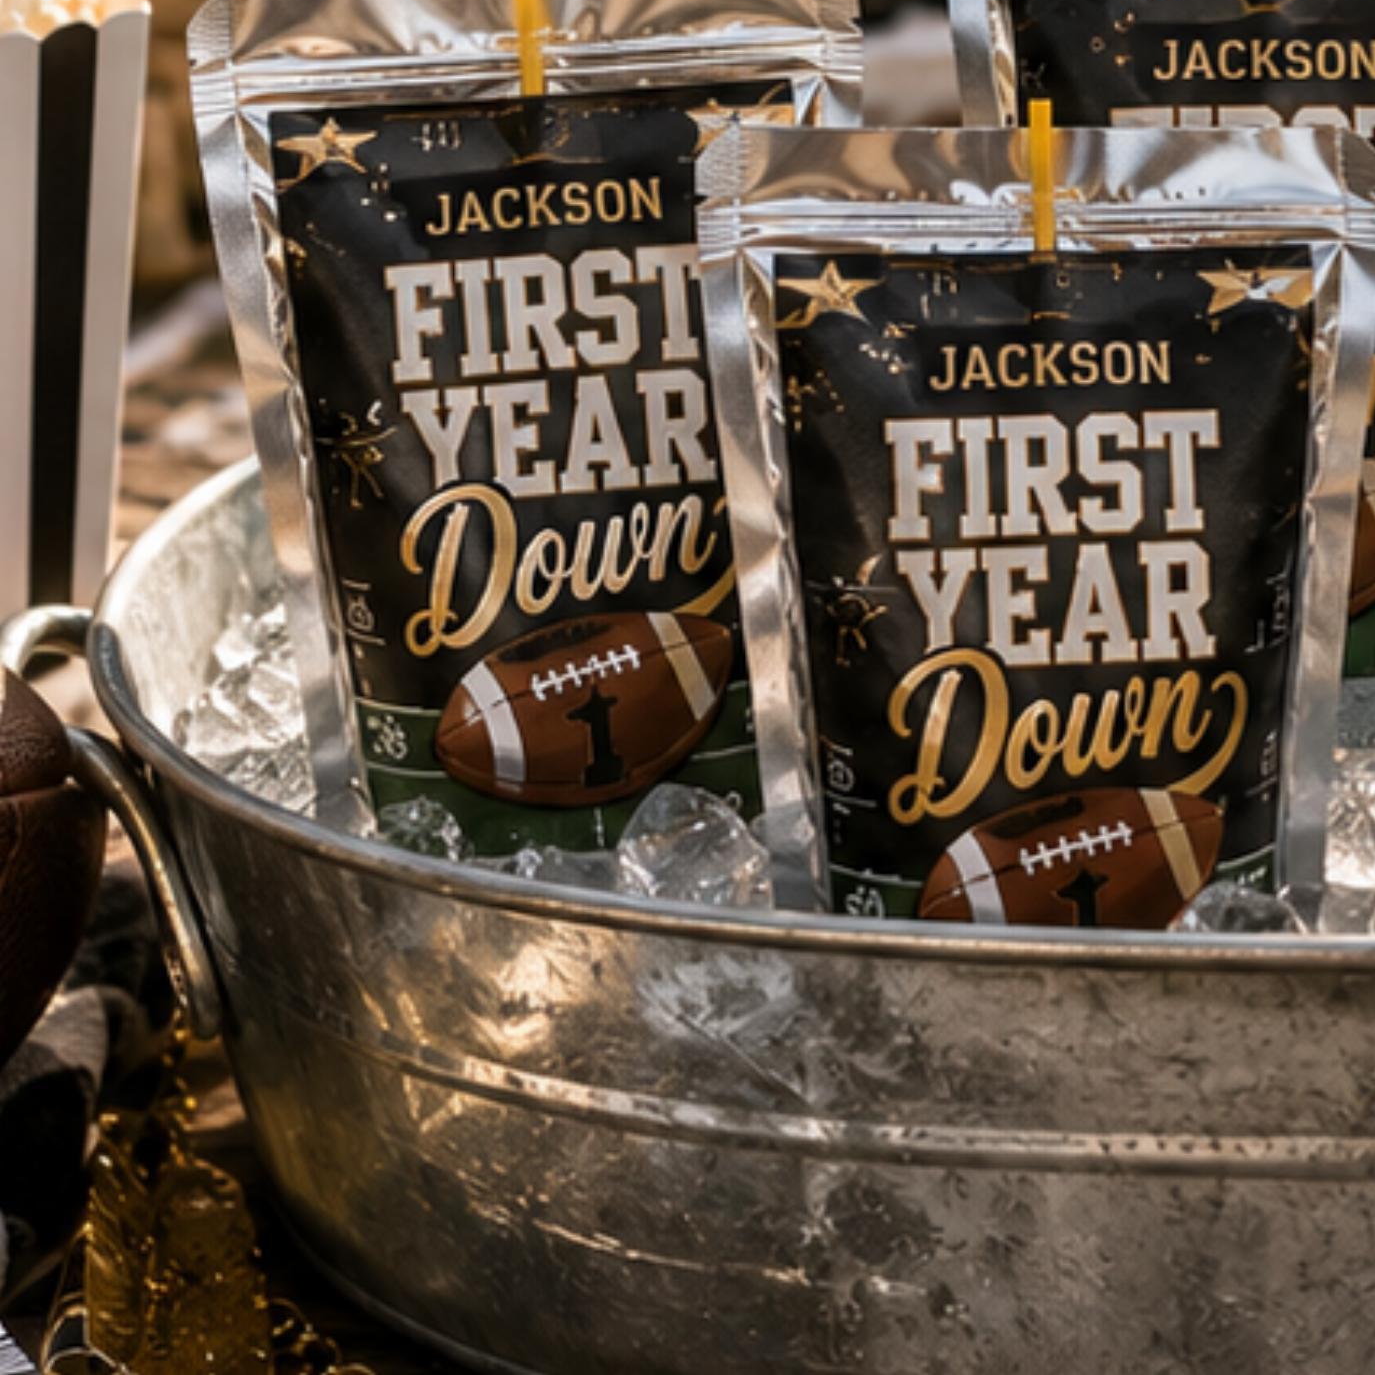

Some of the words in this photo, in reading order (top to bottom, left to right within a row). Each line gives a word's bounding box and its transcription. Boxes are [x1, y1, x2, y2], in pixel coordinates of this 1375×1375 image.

[425, 176, 663, 237] JACKSON
[382, 245, 700, 385] FIRST
[928, 339, 1171, 392] JACKSON
[399, 368, 718, 500] YEAR
[883, 407, 1222, 543] FIRST
[399, 482, 724, 658] Down
[894, 538, 1218, 668] YEAR
[887, 646, 1248, 824] Down
